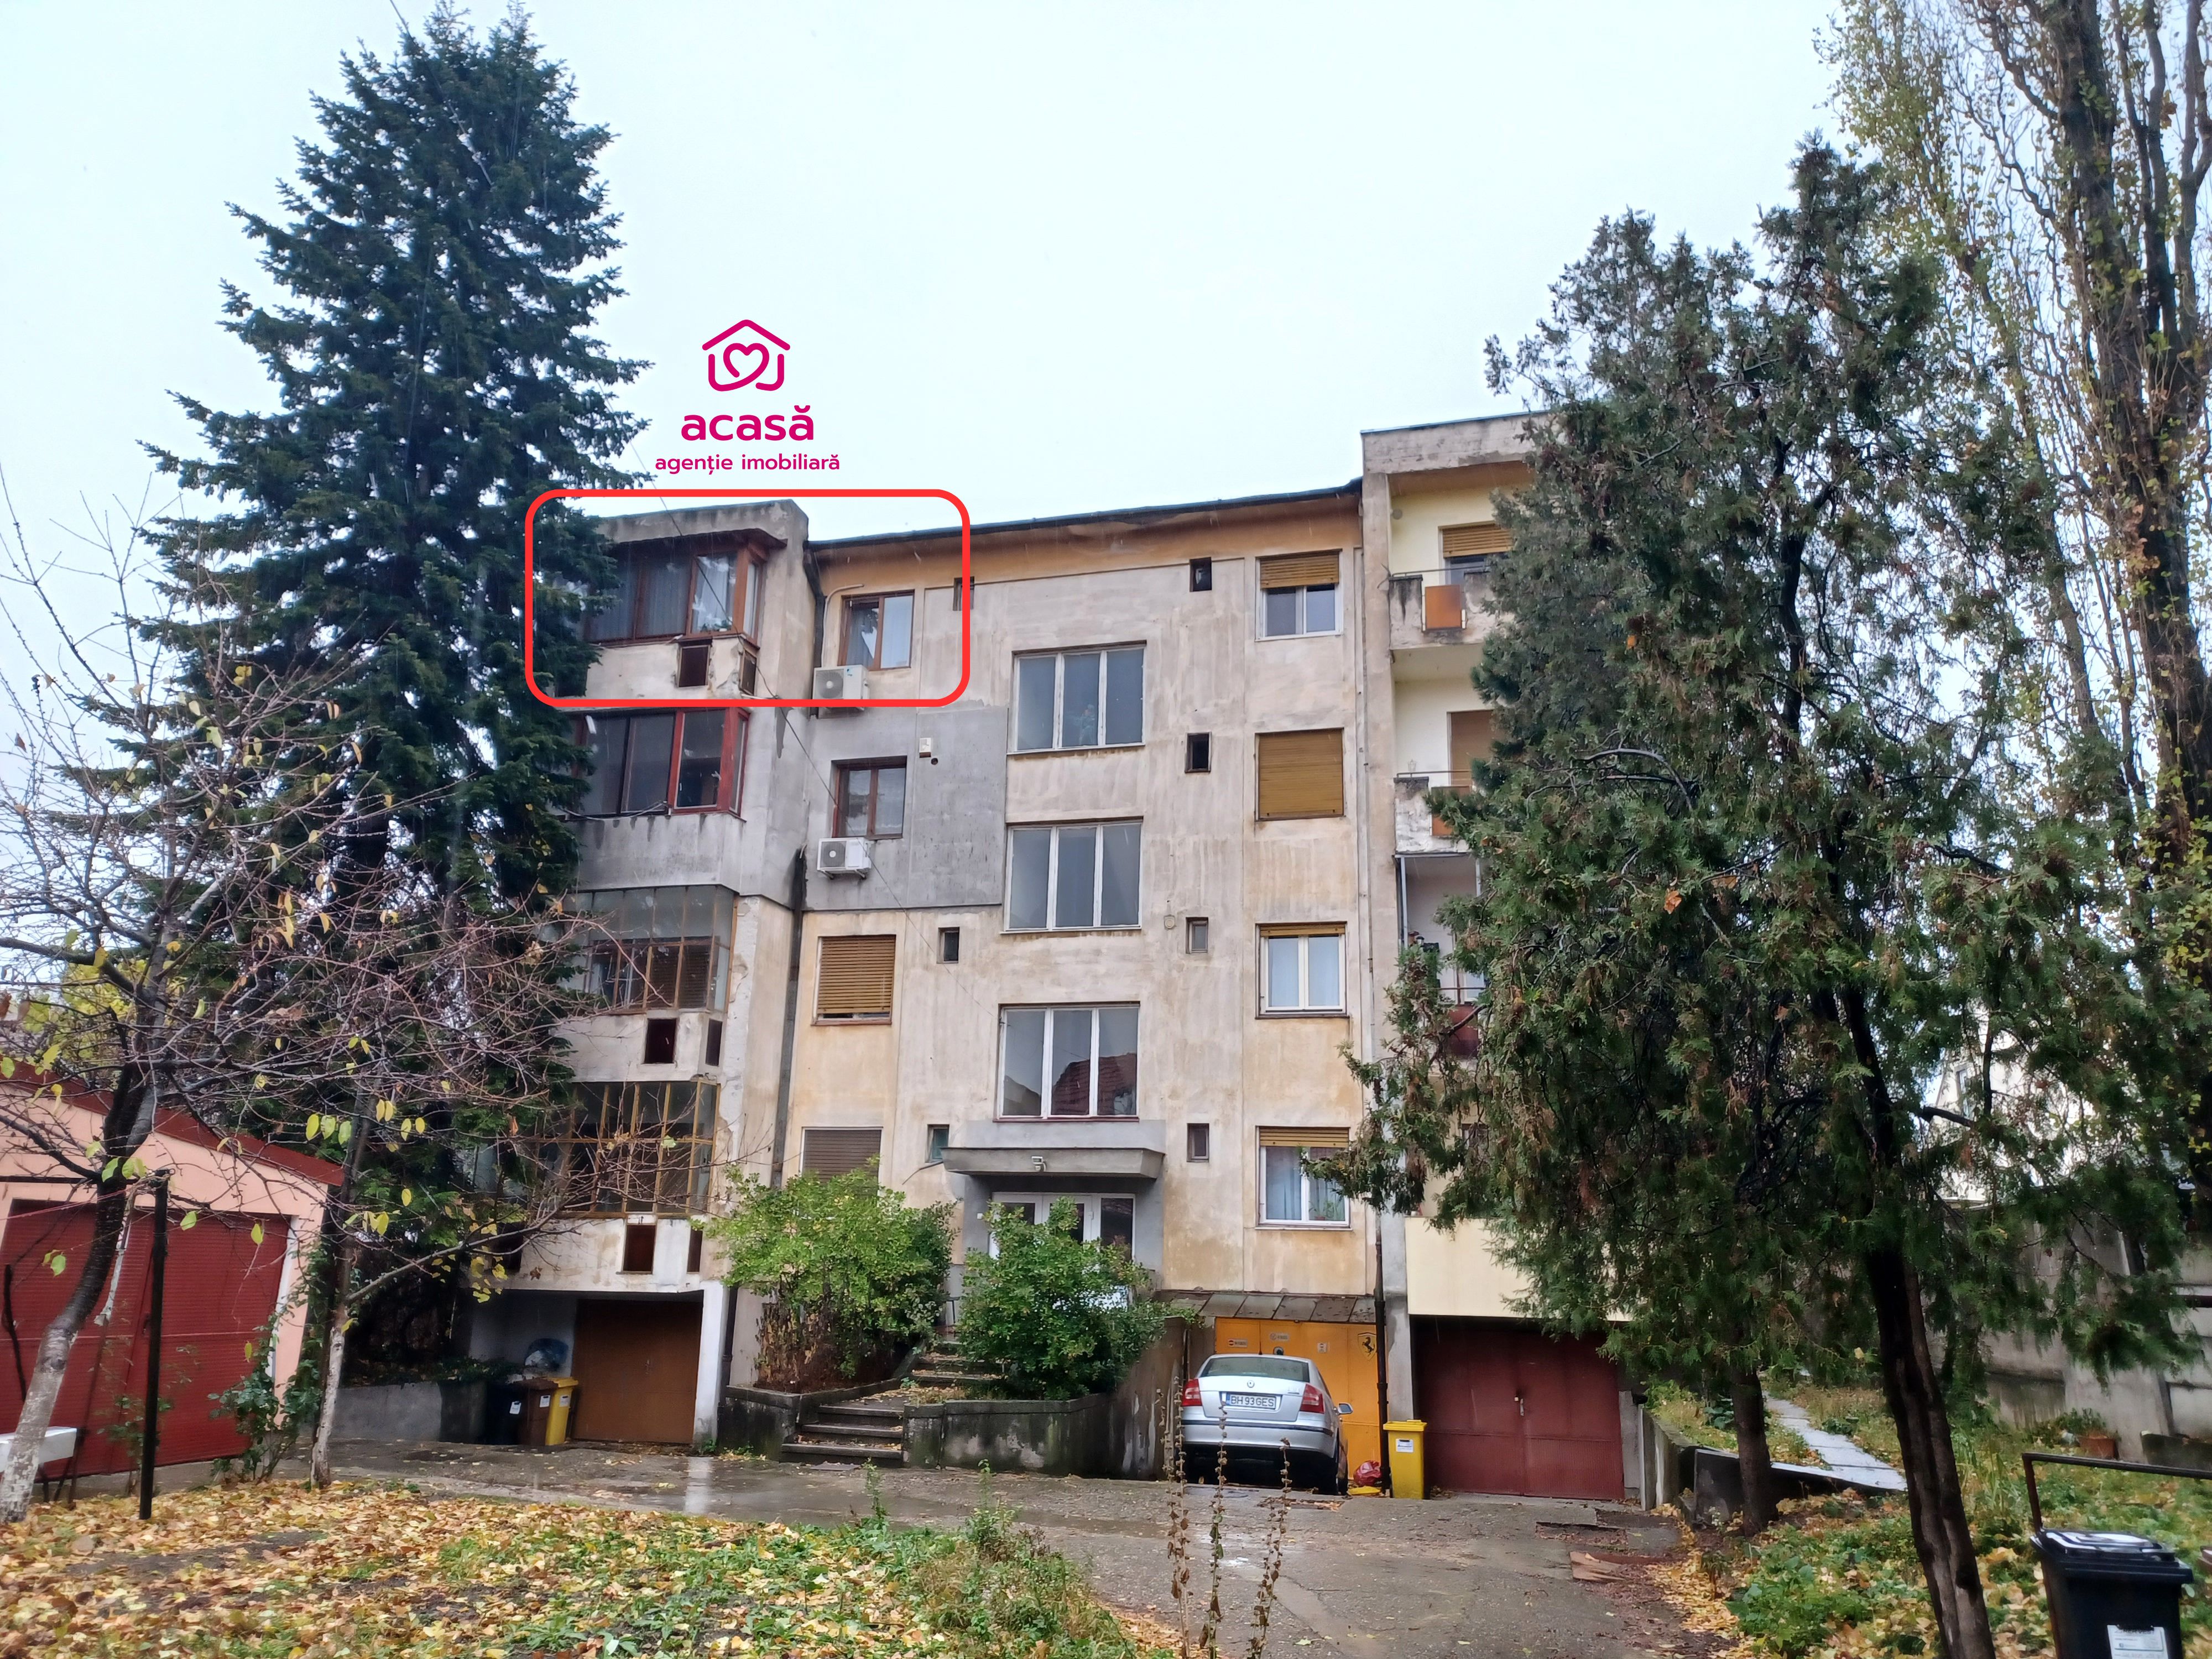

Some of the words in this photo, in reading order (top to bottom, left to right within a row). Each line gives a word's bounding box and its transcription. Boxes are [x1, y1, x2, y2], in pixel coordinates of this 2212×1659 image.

[1230, 1395, 1243, 1405] BH
[1245, 1397, 1254, 1406] 93
[1256, 1397, 1274, 1407] GES
